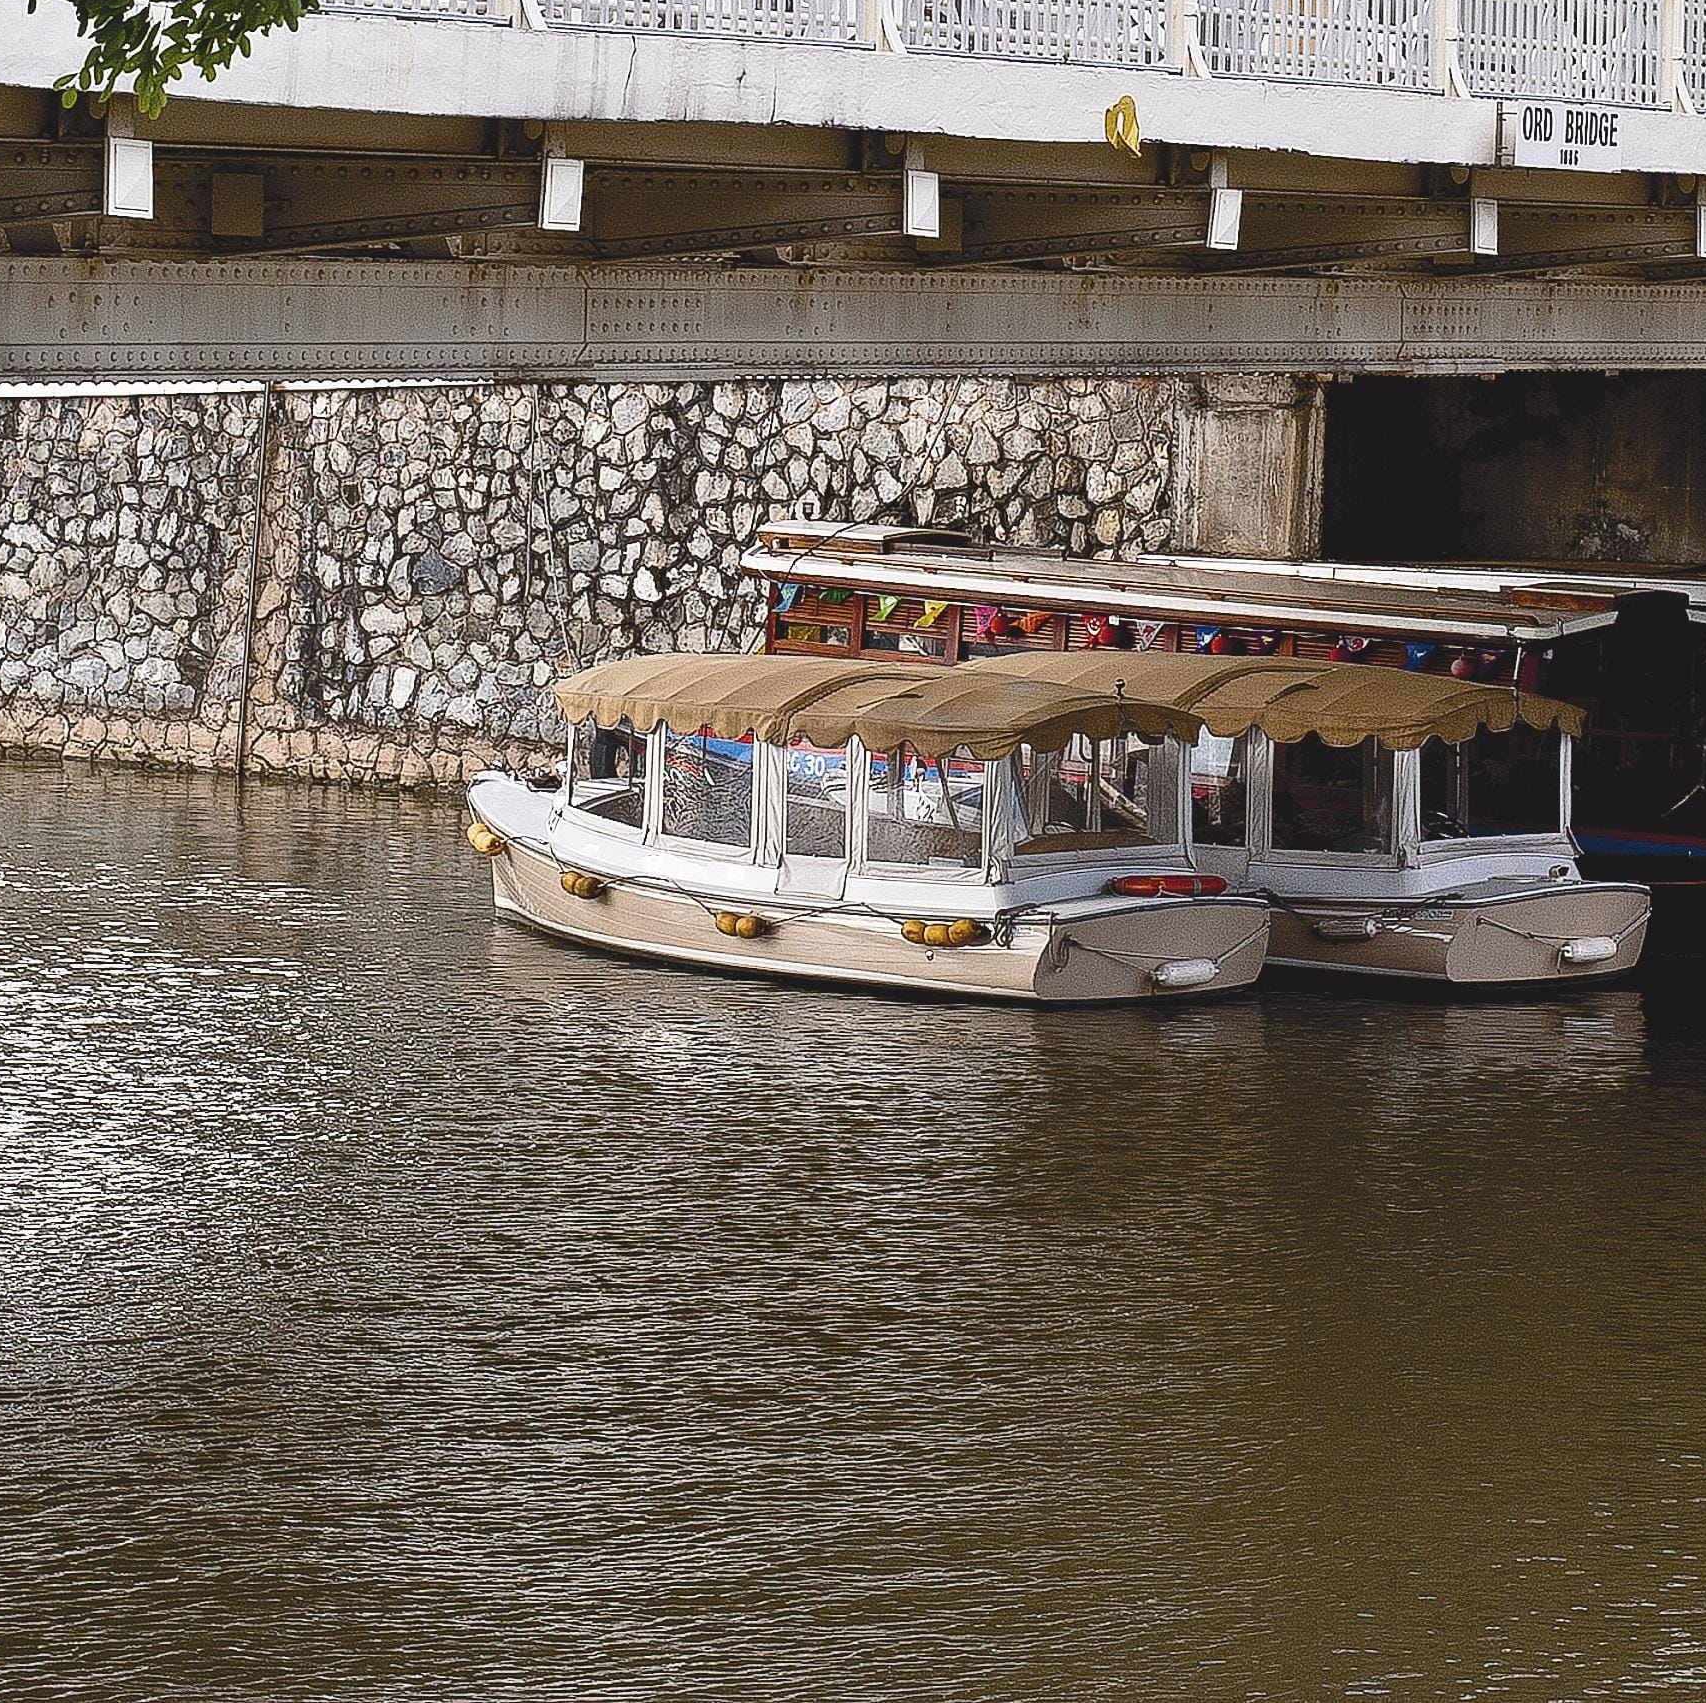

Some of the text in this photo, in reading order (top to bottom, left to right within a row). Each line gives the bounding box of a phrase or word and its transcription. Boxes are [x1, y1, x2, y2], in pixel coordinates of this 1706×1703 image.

[1522, 105, 1619, 147] ORD BRIDGE
[803, 754, 826, 777] 30
